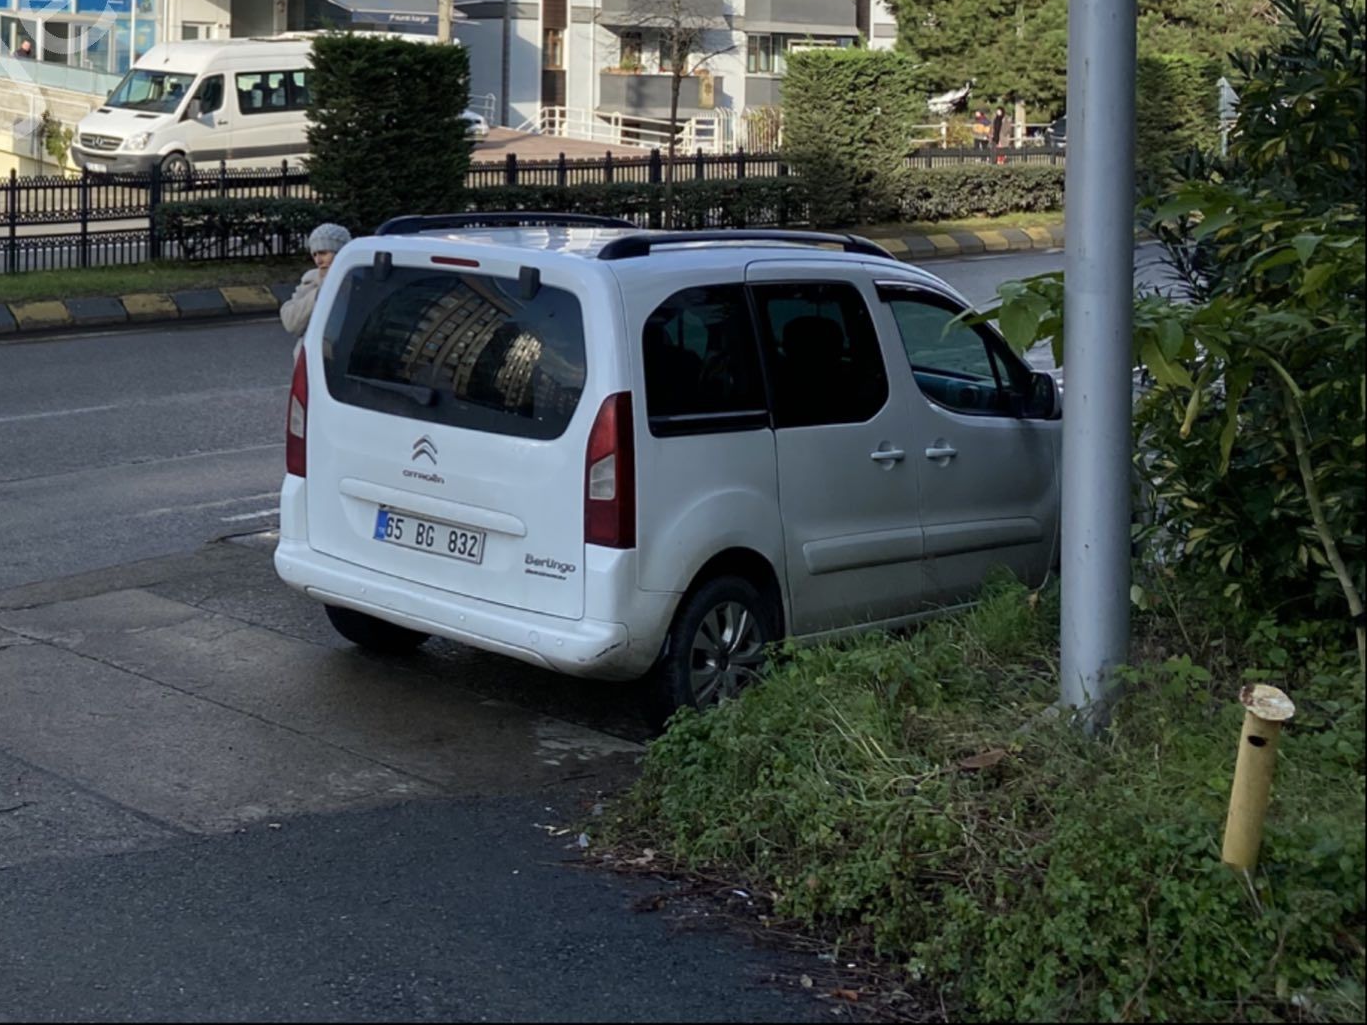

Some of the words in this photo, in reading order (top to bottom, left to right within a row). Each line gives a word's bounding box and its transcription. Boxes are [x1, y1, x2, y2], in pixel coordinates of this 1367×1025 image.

[385, 516, 404, 540] 65
[415, 523, 435, 547] BG
[447, 530, 479, 558] 832
